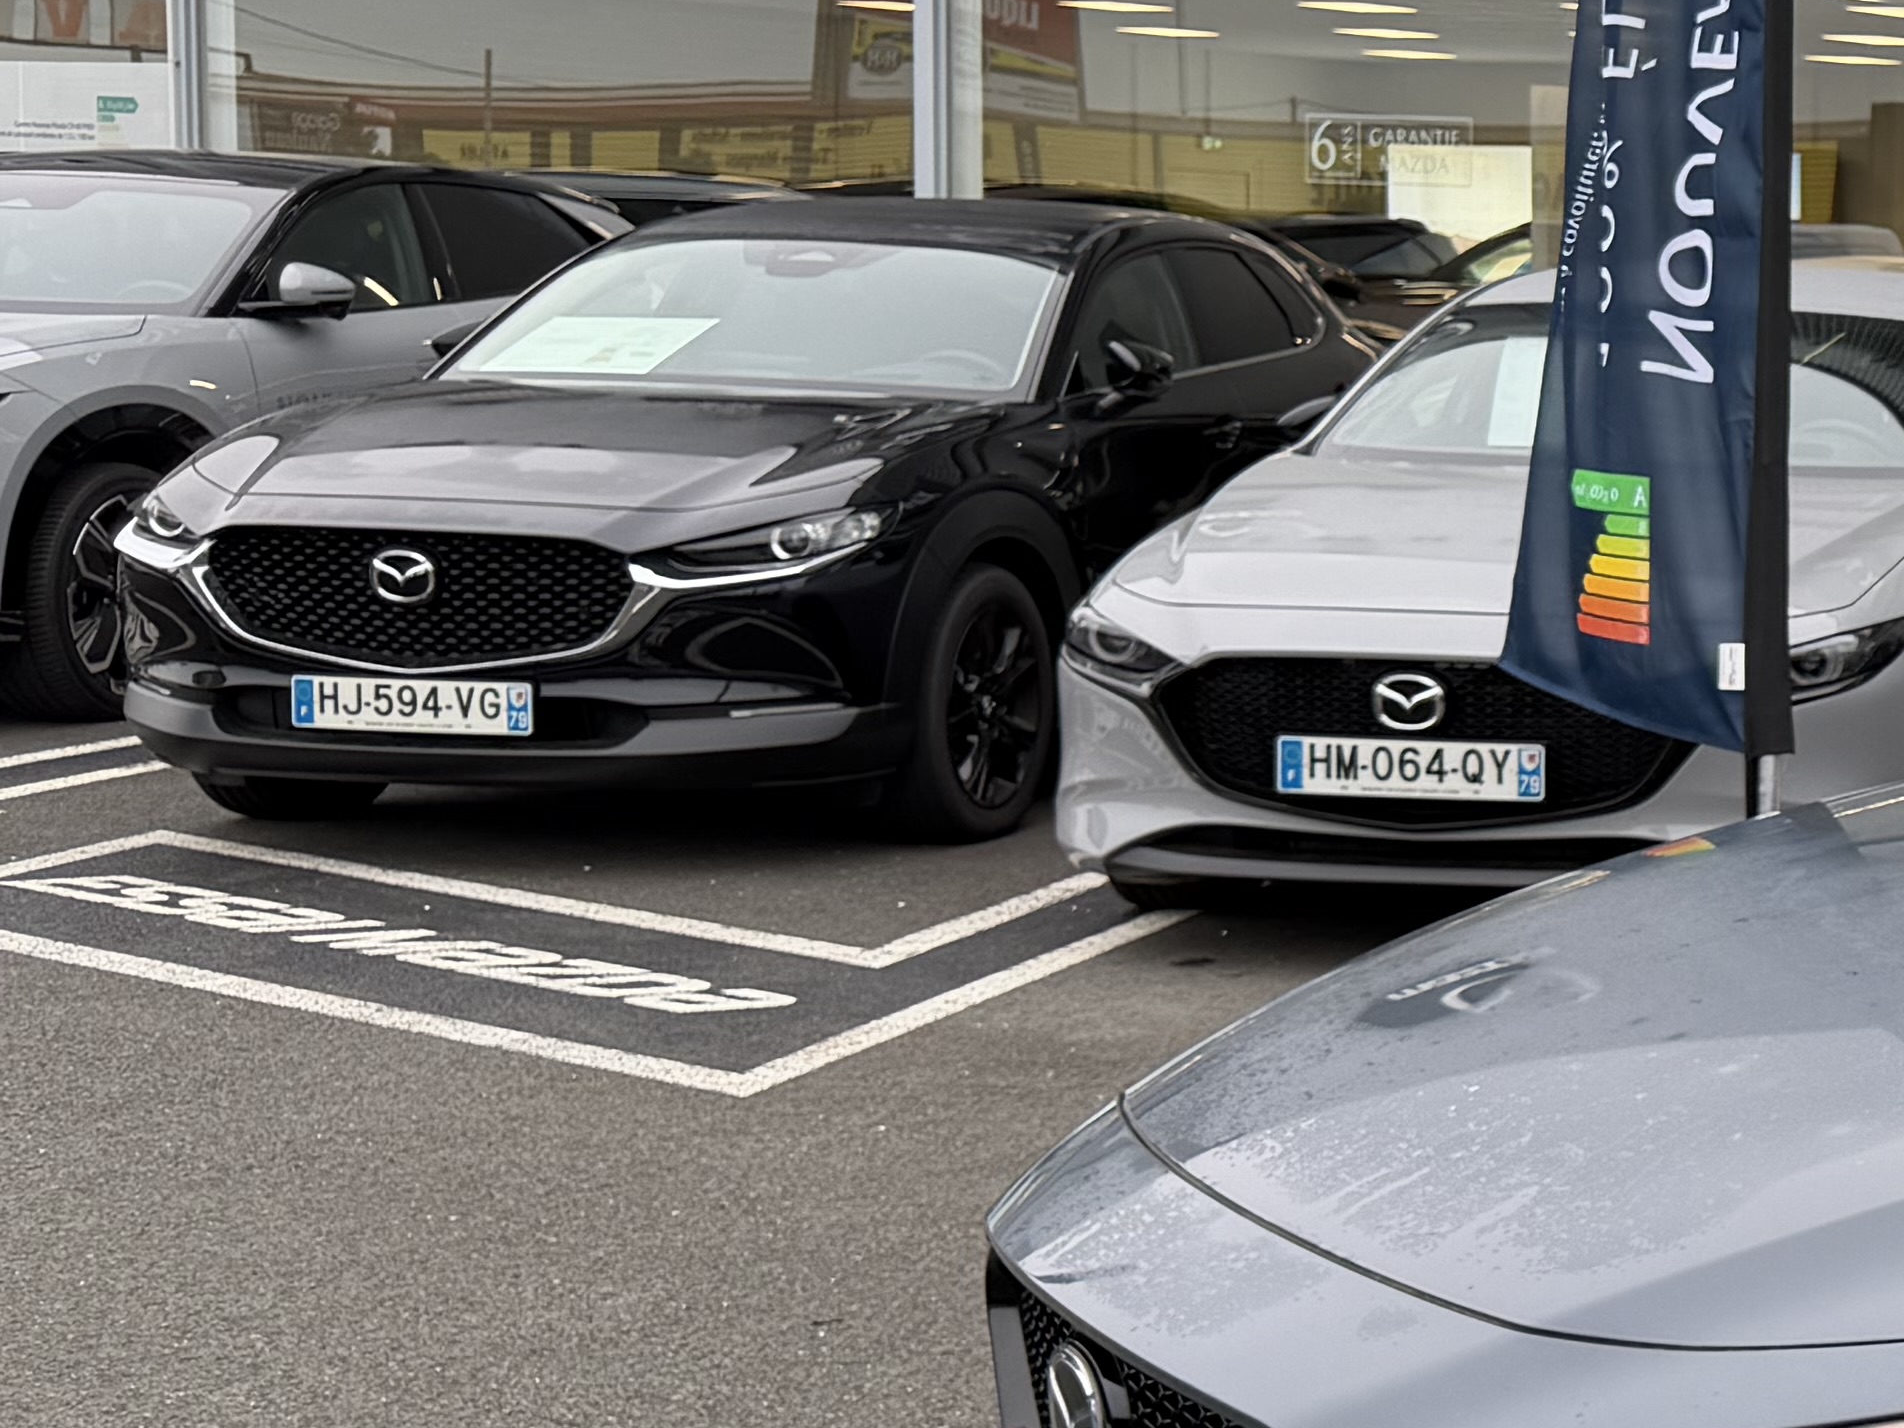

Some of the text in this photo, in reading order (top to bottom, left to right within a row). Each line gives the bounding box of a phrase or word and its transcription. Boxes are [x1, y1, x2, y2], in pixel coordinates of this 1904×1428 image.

[1311, 119, 1338, 170] 6
[1369, 127, 1461, 148] GARANTIE
[319, 682, 500, 719] HJ-594-VG
[510, 711, 527, 729] 79
[1309, 743, 1511, 785] HM-064-QY
[1520, 775, 1540, 794] 79
